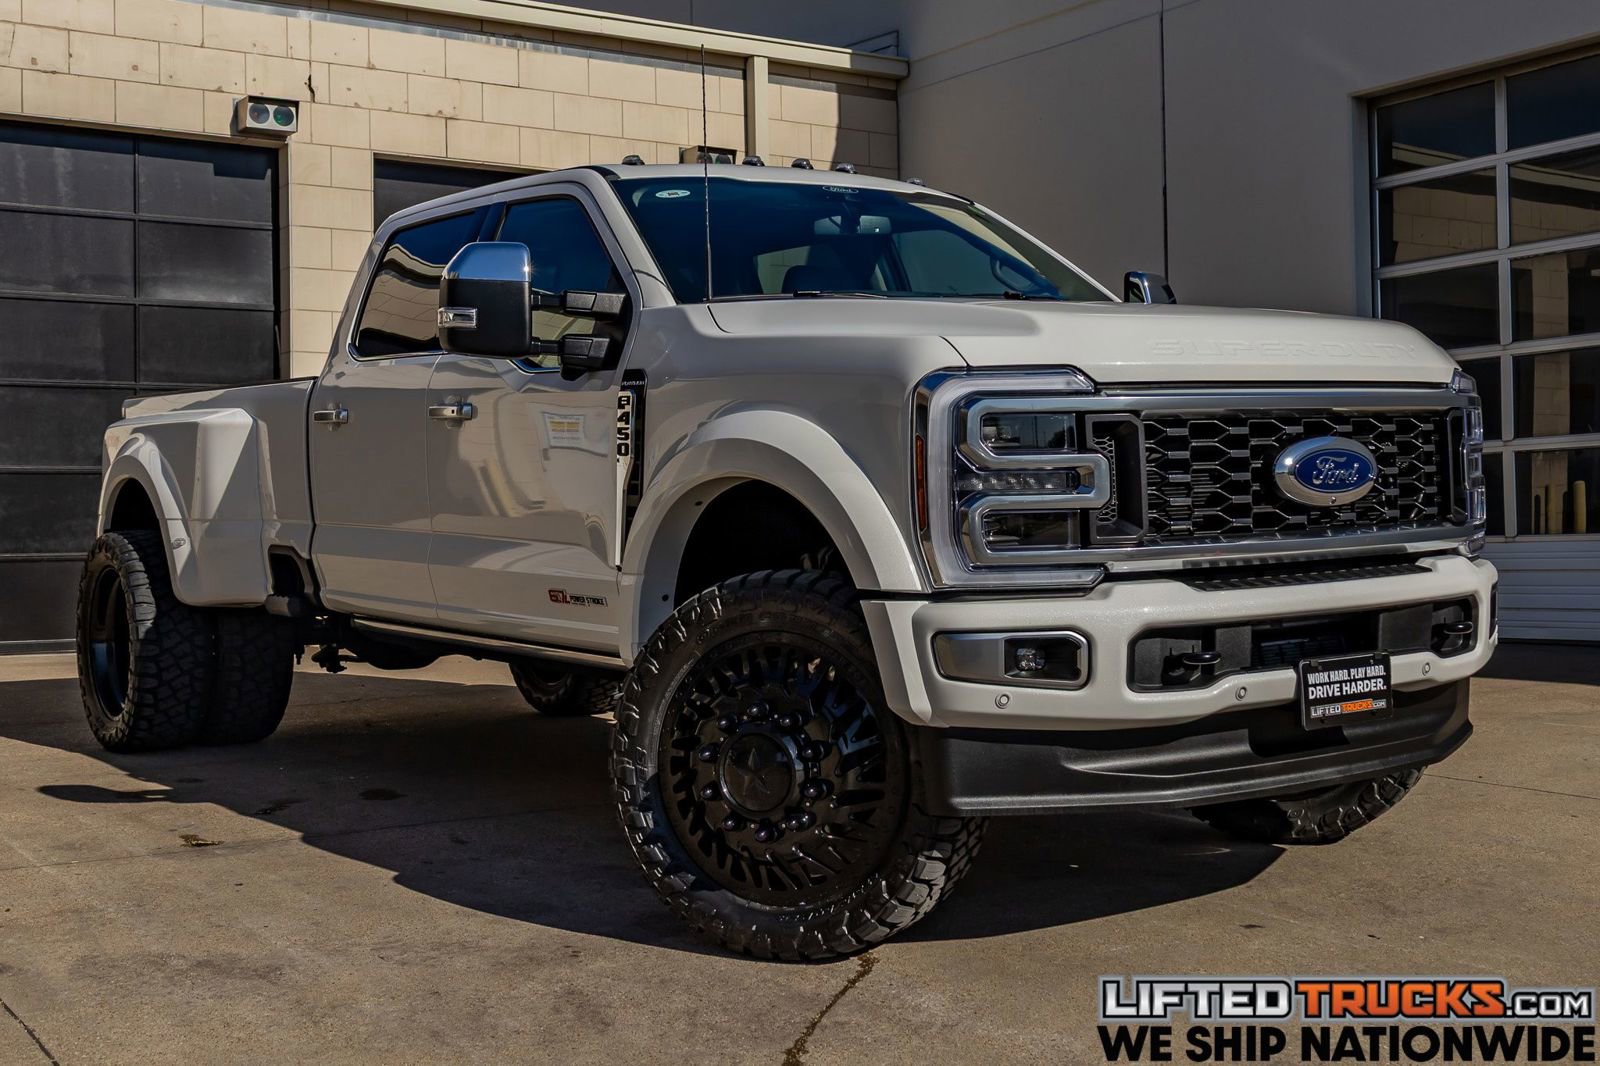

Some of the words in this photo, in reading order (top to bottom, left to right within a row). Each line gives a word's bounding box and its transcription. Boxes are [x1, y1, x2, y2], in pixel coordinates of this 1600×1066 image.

[1151, 338, 1318, 357] SUPER
[1320, 341, 1416, 359] DUTY
[1312, 455, 1359, 484] Ford
[1307, 672, 1329, 685] WORK
[1330, 669, 1350, 682] HARD.
[1350, 667, 1366, 679] PLAY
[1366, 664, 1386, 677] HARD.
[1308, 684, 1341, 700] DRIVE
[1342, 678, 1387, 696] HARDER.
